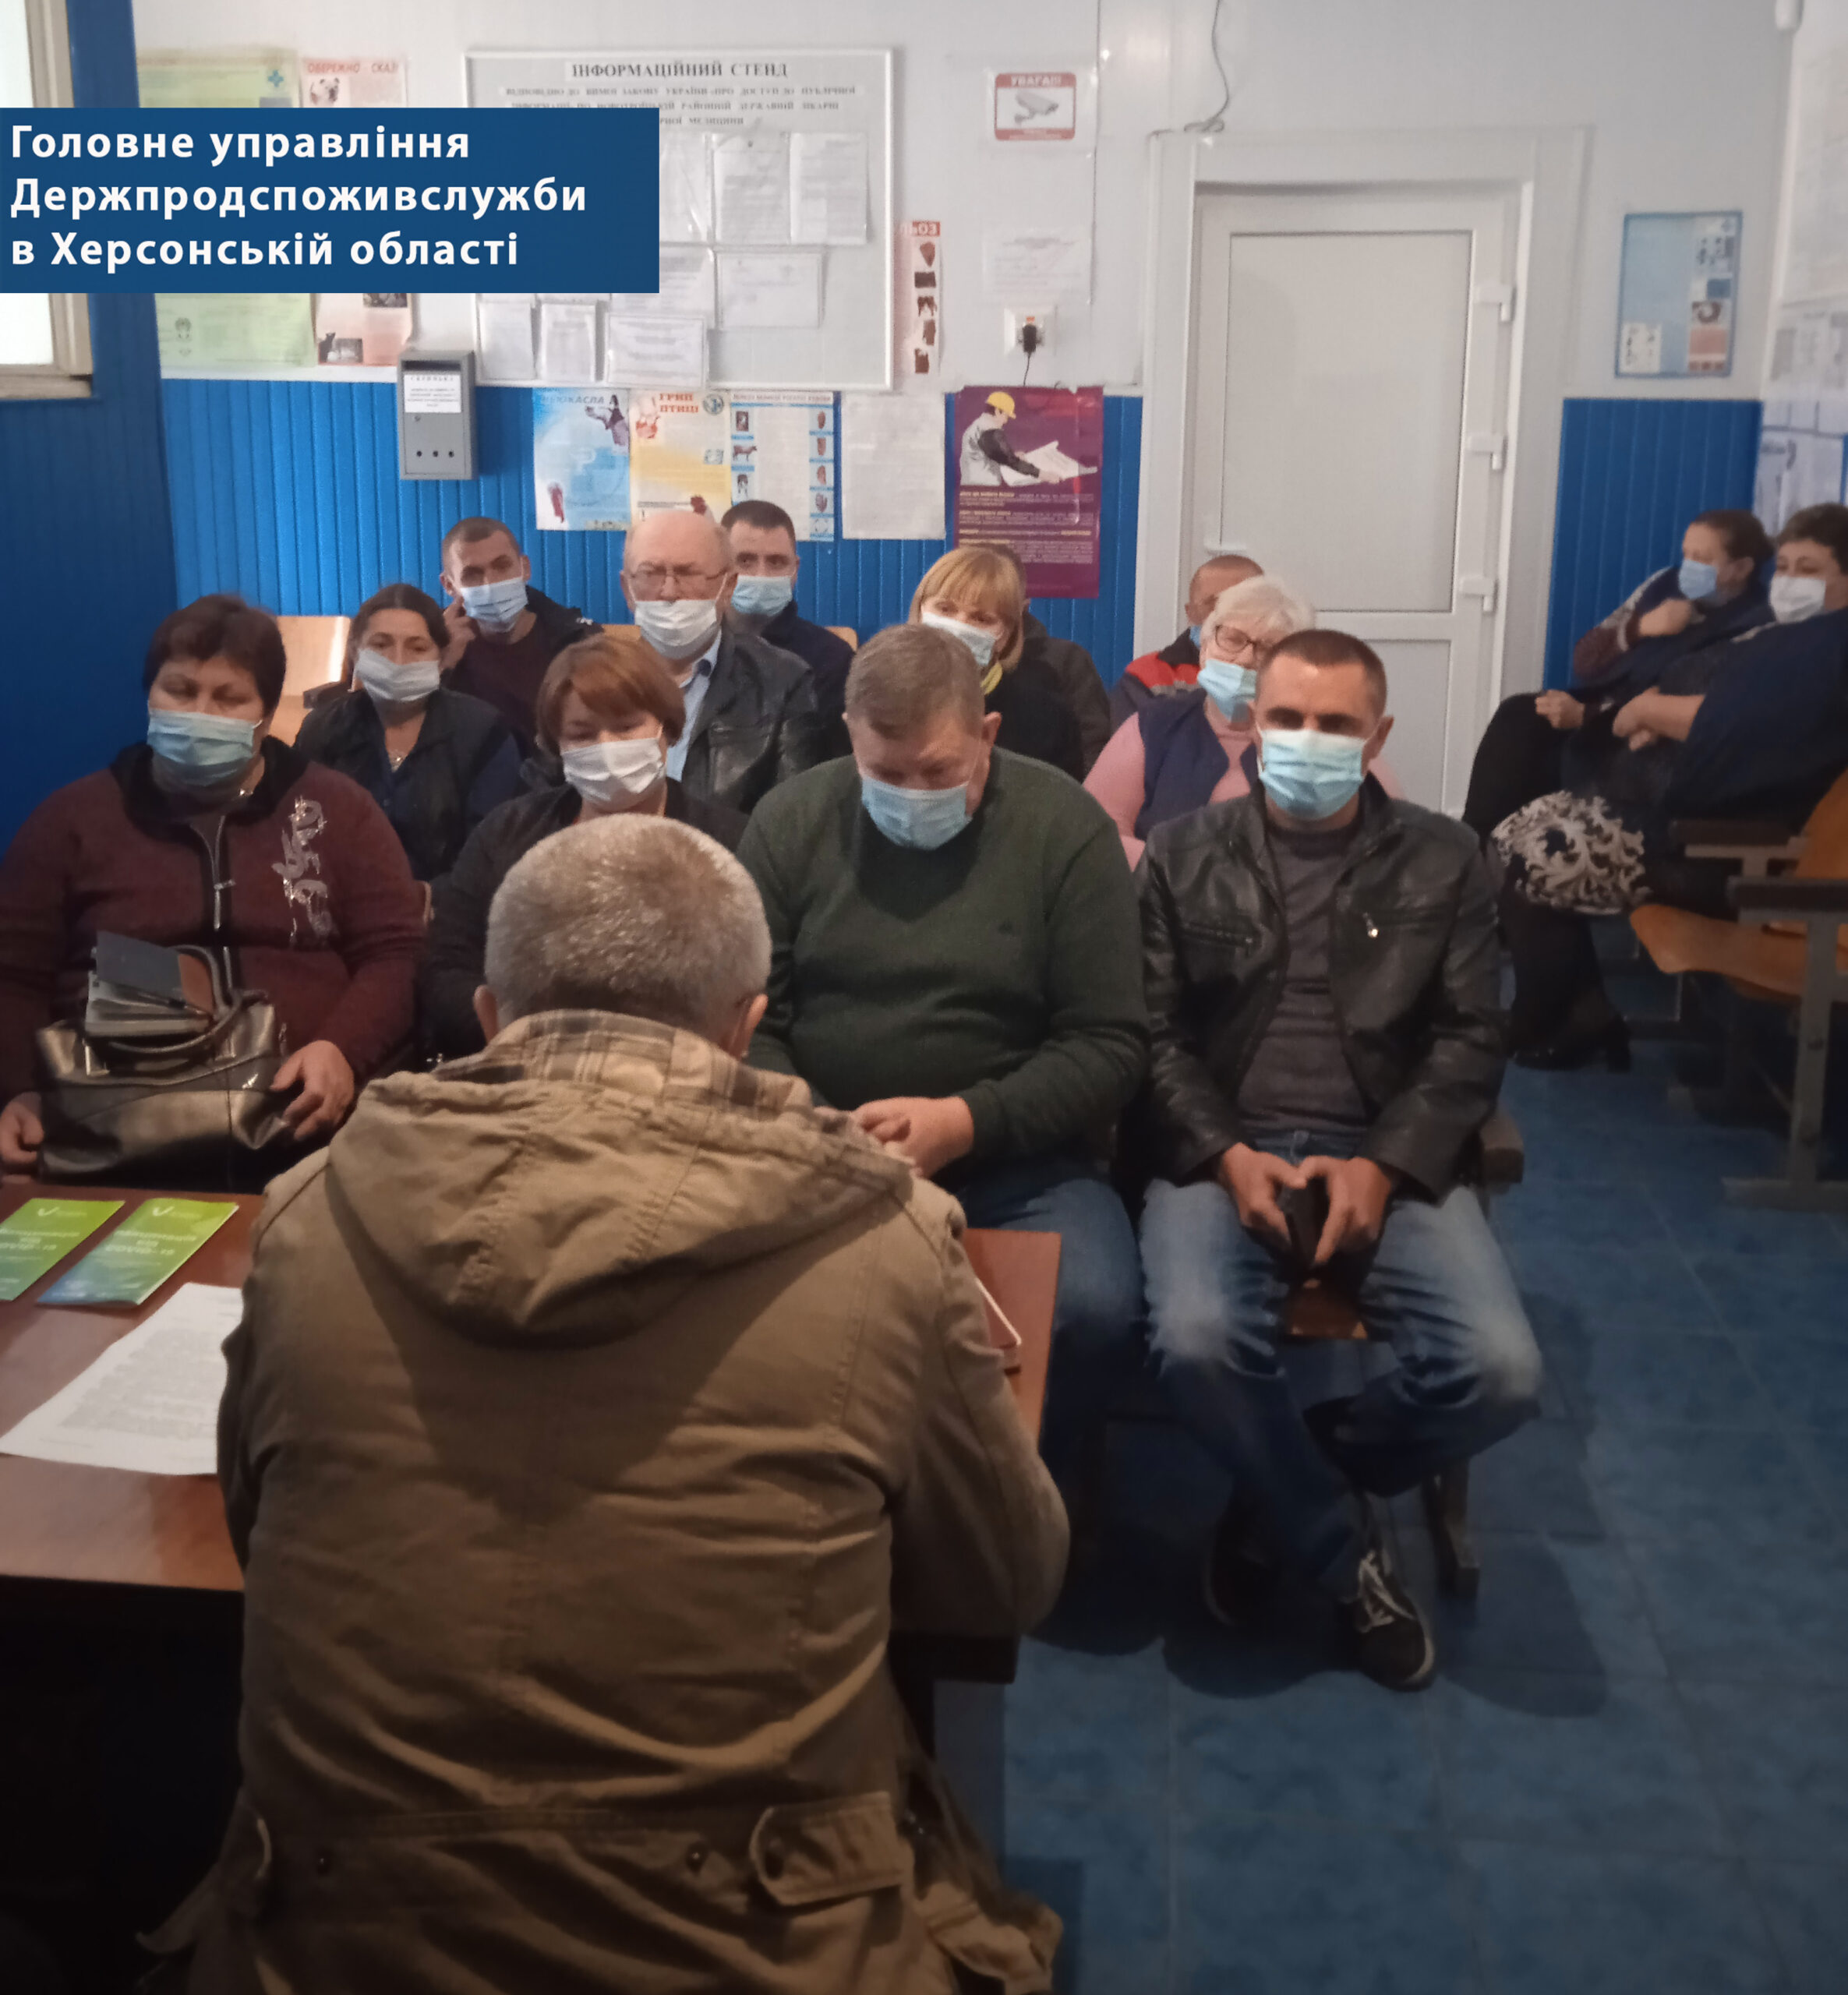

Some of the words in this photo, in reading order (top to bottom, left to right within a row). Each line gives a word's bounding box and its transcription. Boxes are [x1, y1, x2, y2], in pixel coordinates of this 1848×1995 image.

[307, 62, 360, 74] ОБЕРЕЖНО
[572, 60, 723, 78] ІНФОРМАЦІЙНИЙ
[730, 63, 788, 78] СТЕНД
[659, 393, 694, 401] ГРИП
